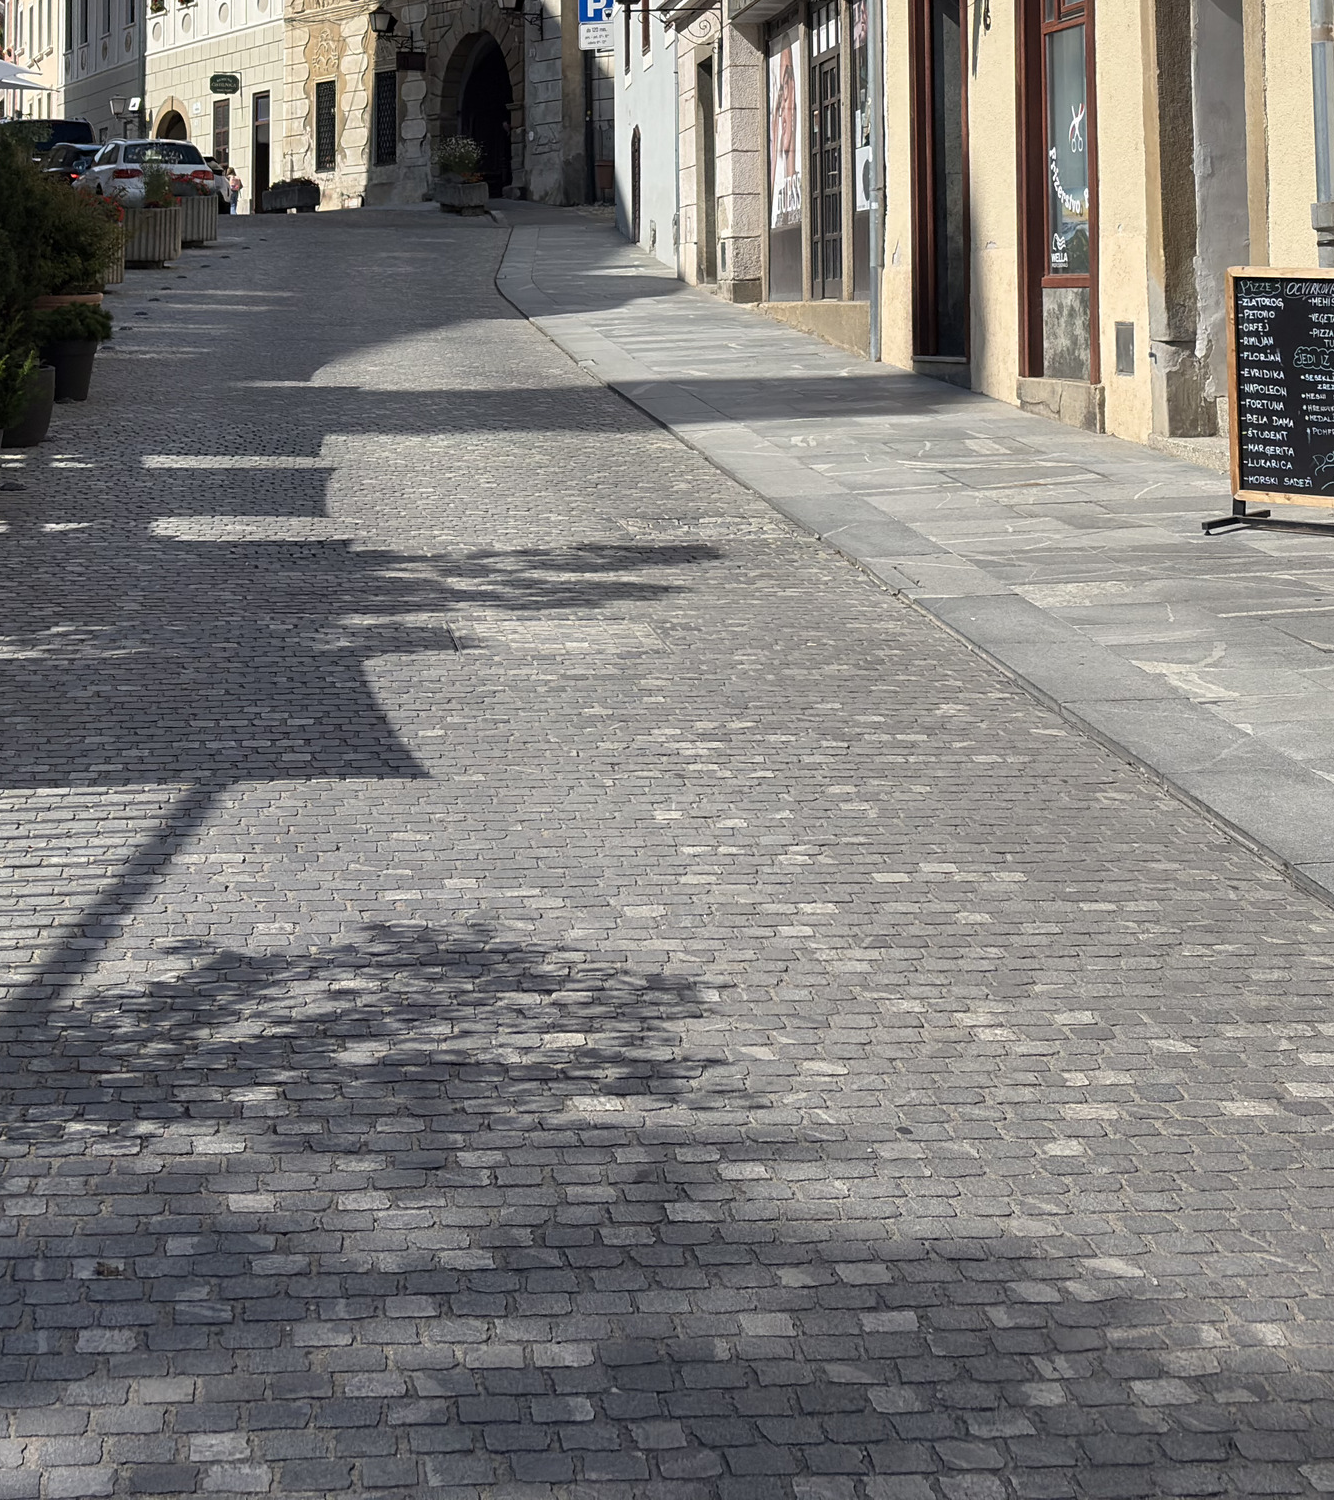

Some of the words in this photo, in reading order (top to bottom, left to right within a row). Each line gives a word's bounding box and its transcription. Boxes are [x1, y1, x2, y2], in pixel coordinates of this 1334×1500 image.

[1051, 252, 1068, 263] WELLA
[1313, 328, 1334, 337] PIZZA
[1296, 350, 1316, 364] JEDI
[1321, 355, 1330, 366] IZ
[1244, 368, 1285, 380] EVRIDIKA
[1244, 384, 1287, 397] NAPOLEON
[1246, 399, 1285, 411] FORTUNA
[1246, 414, 1268, 424] BELA
[1272, 416, 1294, 428] DAMA
[1247, 428, 1288, 440] ŠTUDENT
[1248, 443, 1295, 457] MARGERITA
[1248, 475, 1278, 485] MORSKI
